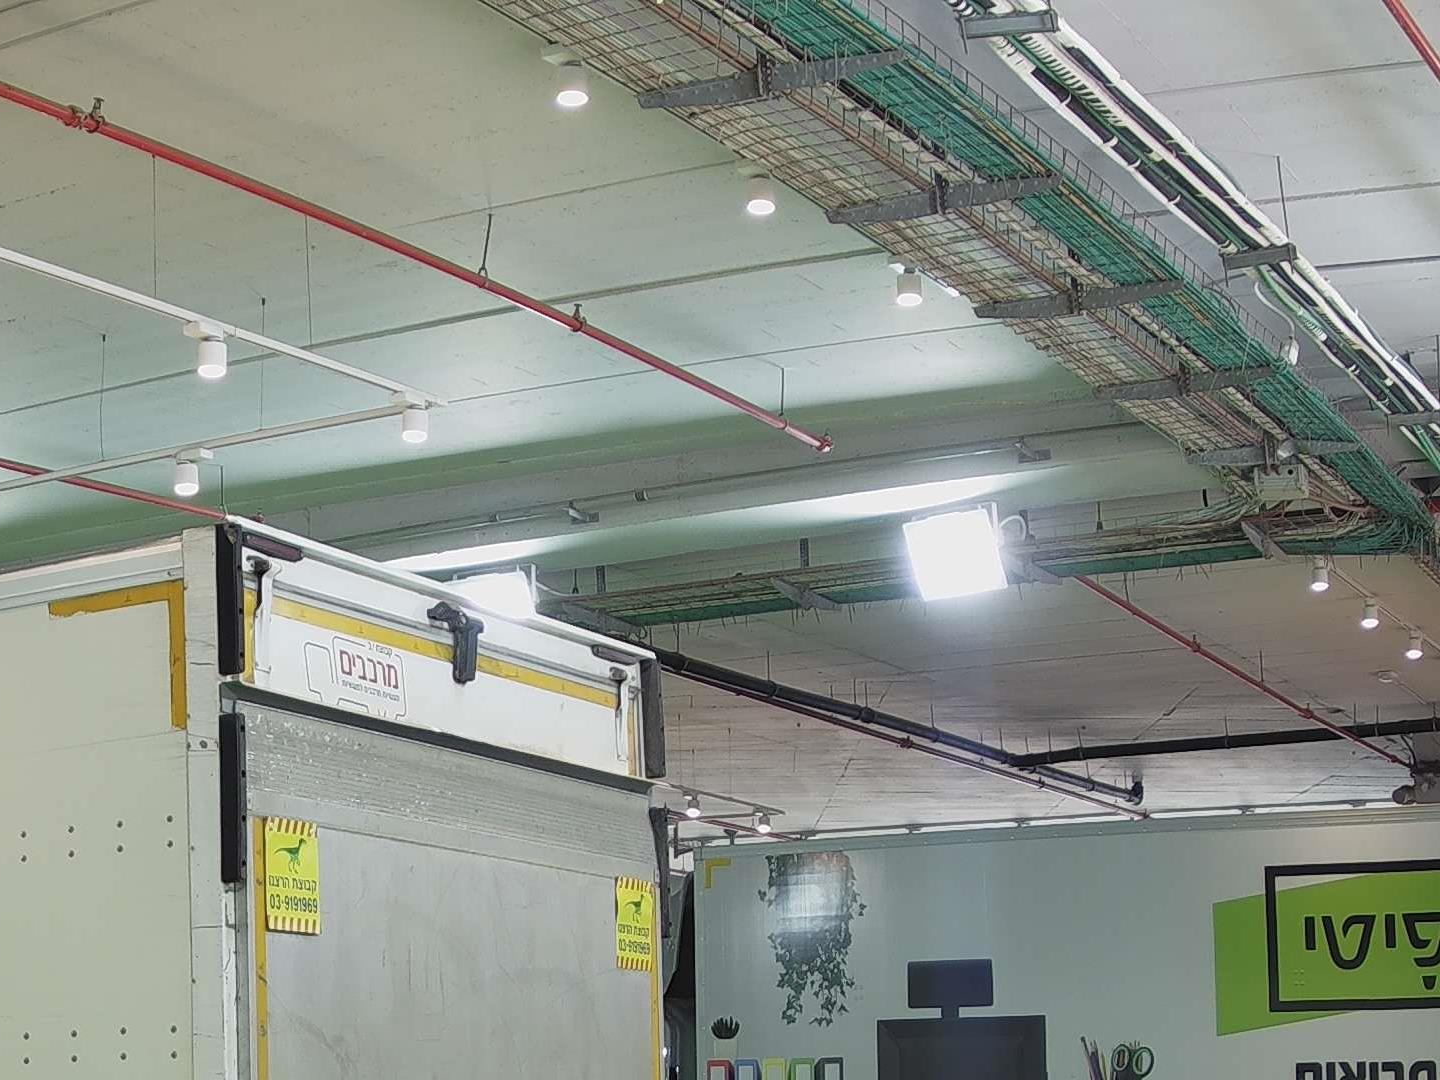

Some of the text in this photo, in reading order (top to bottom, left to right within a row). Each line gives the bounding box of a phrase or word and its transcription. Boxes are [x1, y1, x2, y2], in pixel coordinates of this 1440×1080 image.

[339, 649, 399, 690] מרכבים
[292, 878, 317, 895] קבוצת
[269, 894, 318, 914] 03-9191969
